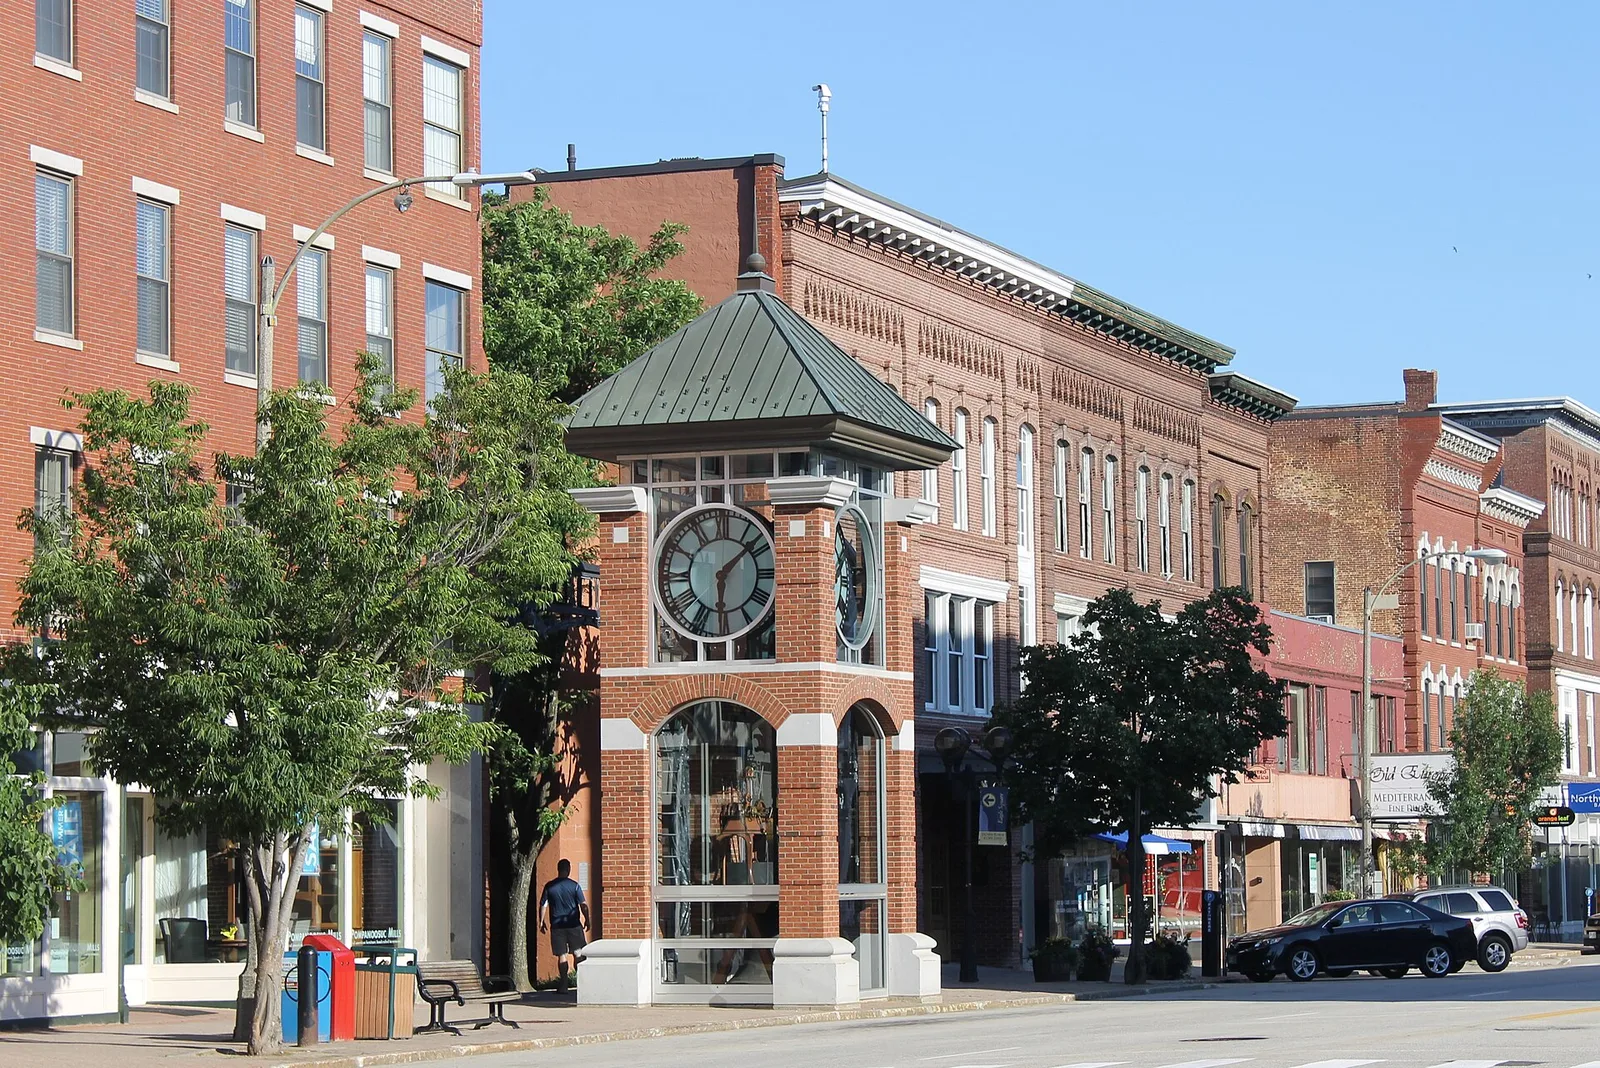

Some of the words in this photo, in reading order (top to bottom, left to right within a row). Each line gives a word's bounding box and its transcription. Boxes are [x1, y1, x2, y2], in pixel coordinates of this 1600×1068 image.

[1370, 766, 1397, 783] Old
[1374, 793, 1432, 802] MEDITERRAN
[351, 928, 387, 939] POMPANOOSUC
[388, 926, 402, 938] MILLS
